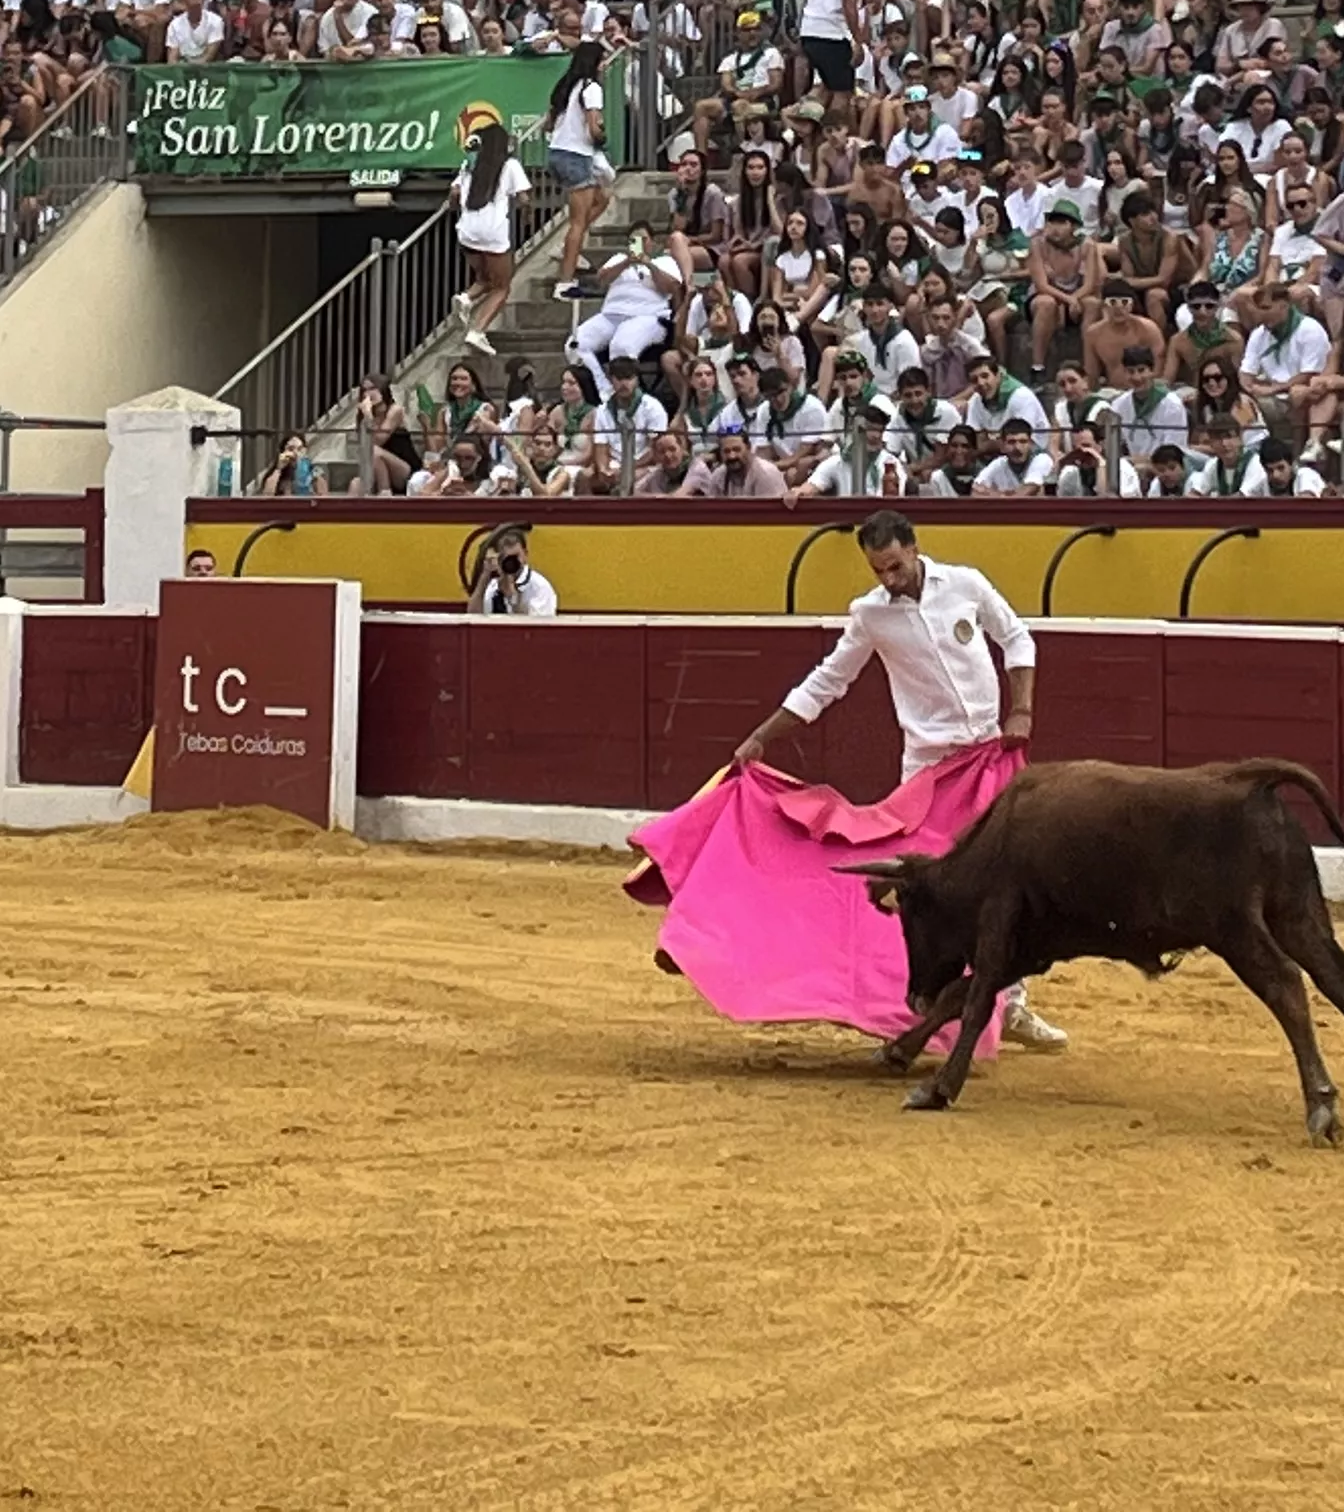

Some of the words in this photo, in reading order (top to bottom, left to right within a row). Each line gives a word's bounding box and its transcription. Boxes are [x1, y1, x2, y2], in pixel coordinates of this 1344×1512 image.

[143, 78, 227, 118] ¡Feliz
[160, 116, 240, 157] San
[250, 110, 440, 156] Lorenzo!
[349, 169, 401, 187] SALIDA
